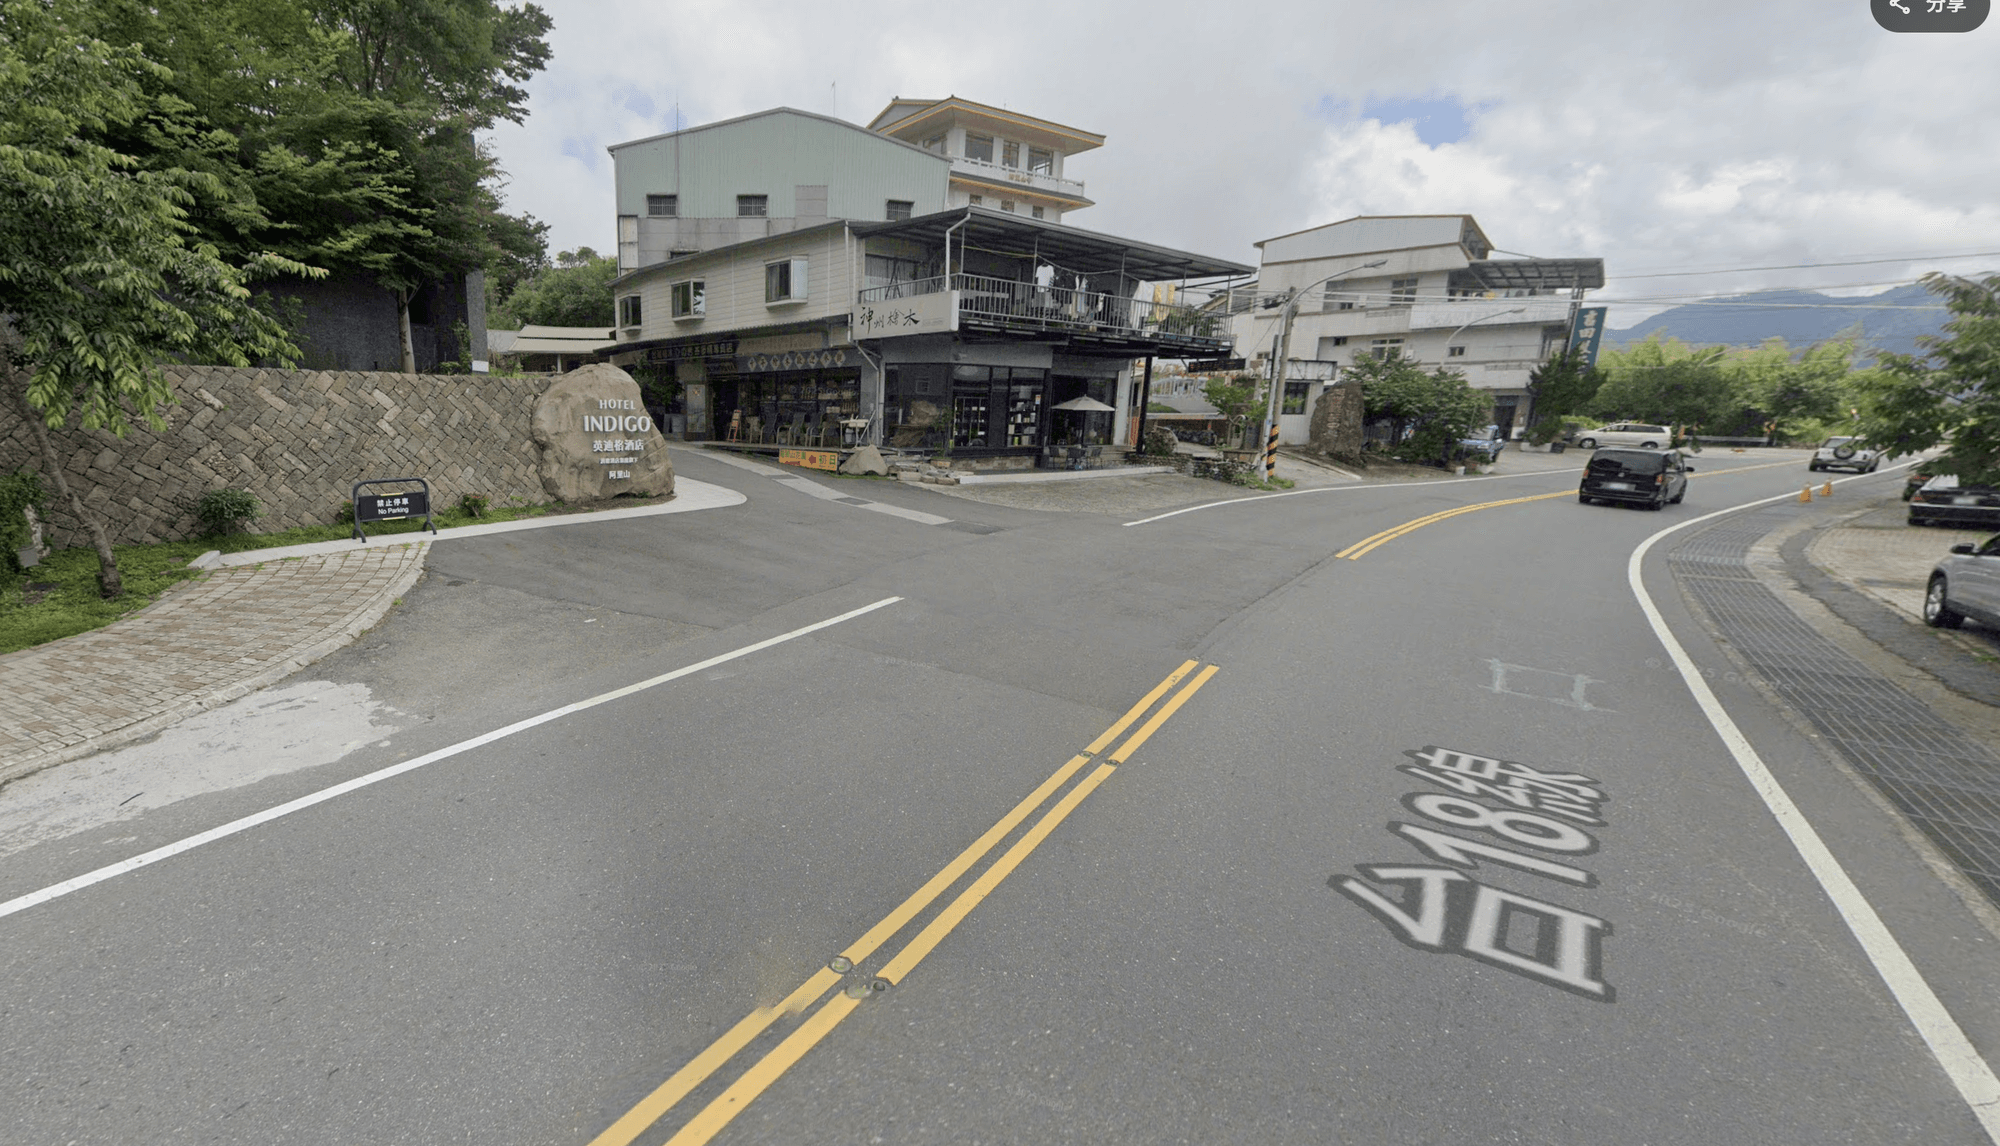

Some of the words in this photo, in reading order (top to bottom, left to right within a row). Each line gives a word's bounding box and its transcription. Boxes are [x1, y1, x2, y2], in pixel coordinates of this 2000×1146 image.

[599, 399, 636, 410] HOTEL
[583, 415, 651, 432] INDIGO
[593, 439, 644, 452] 英迪格酒店
[608, 470, 631, 480] 阿里山
[377, 497, 409, 507] 禁止停車
[1340, 746, 1609, 998] 台18線
